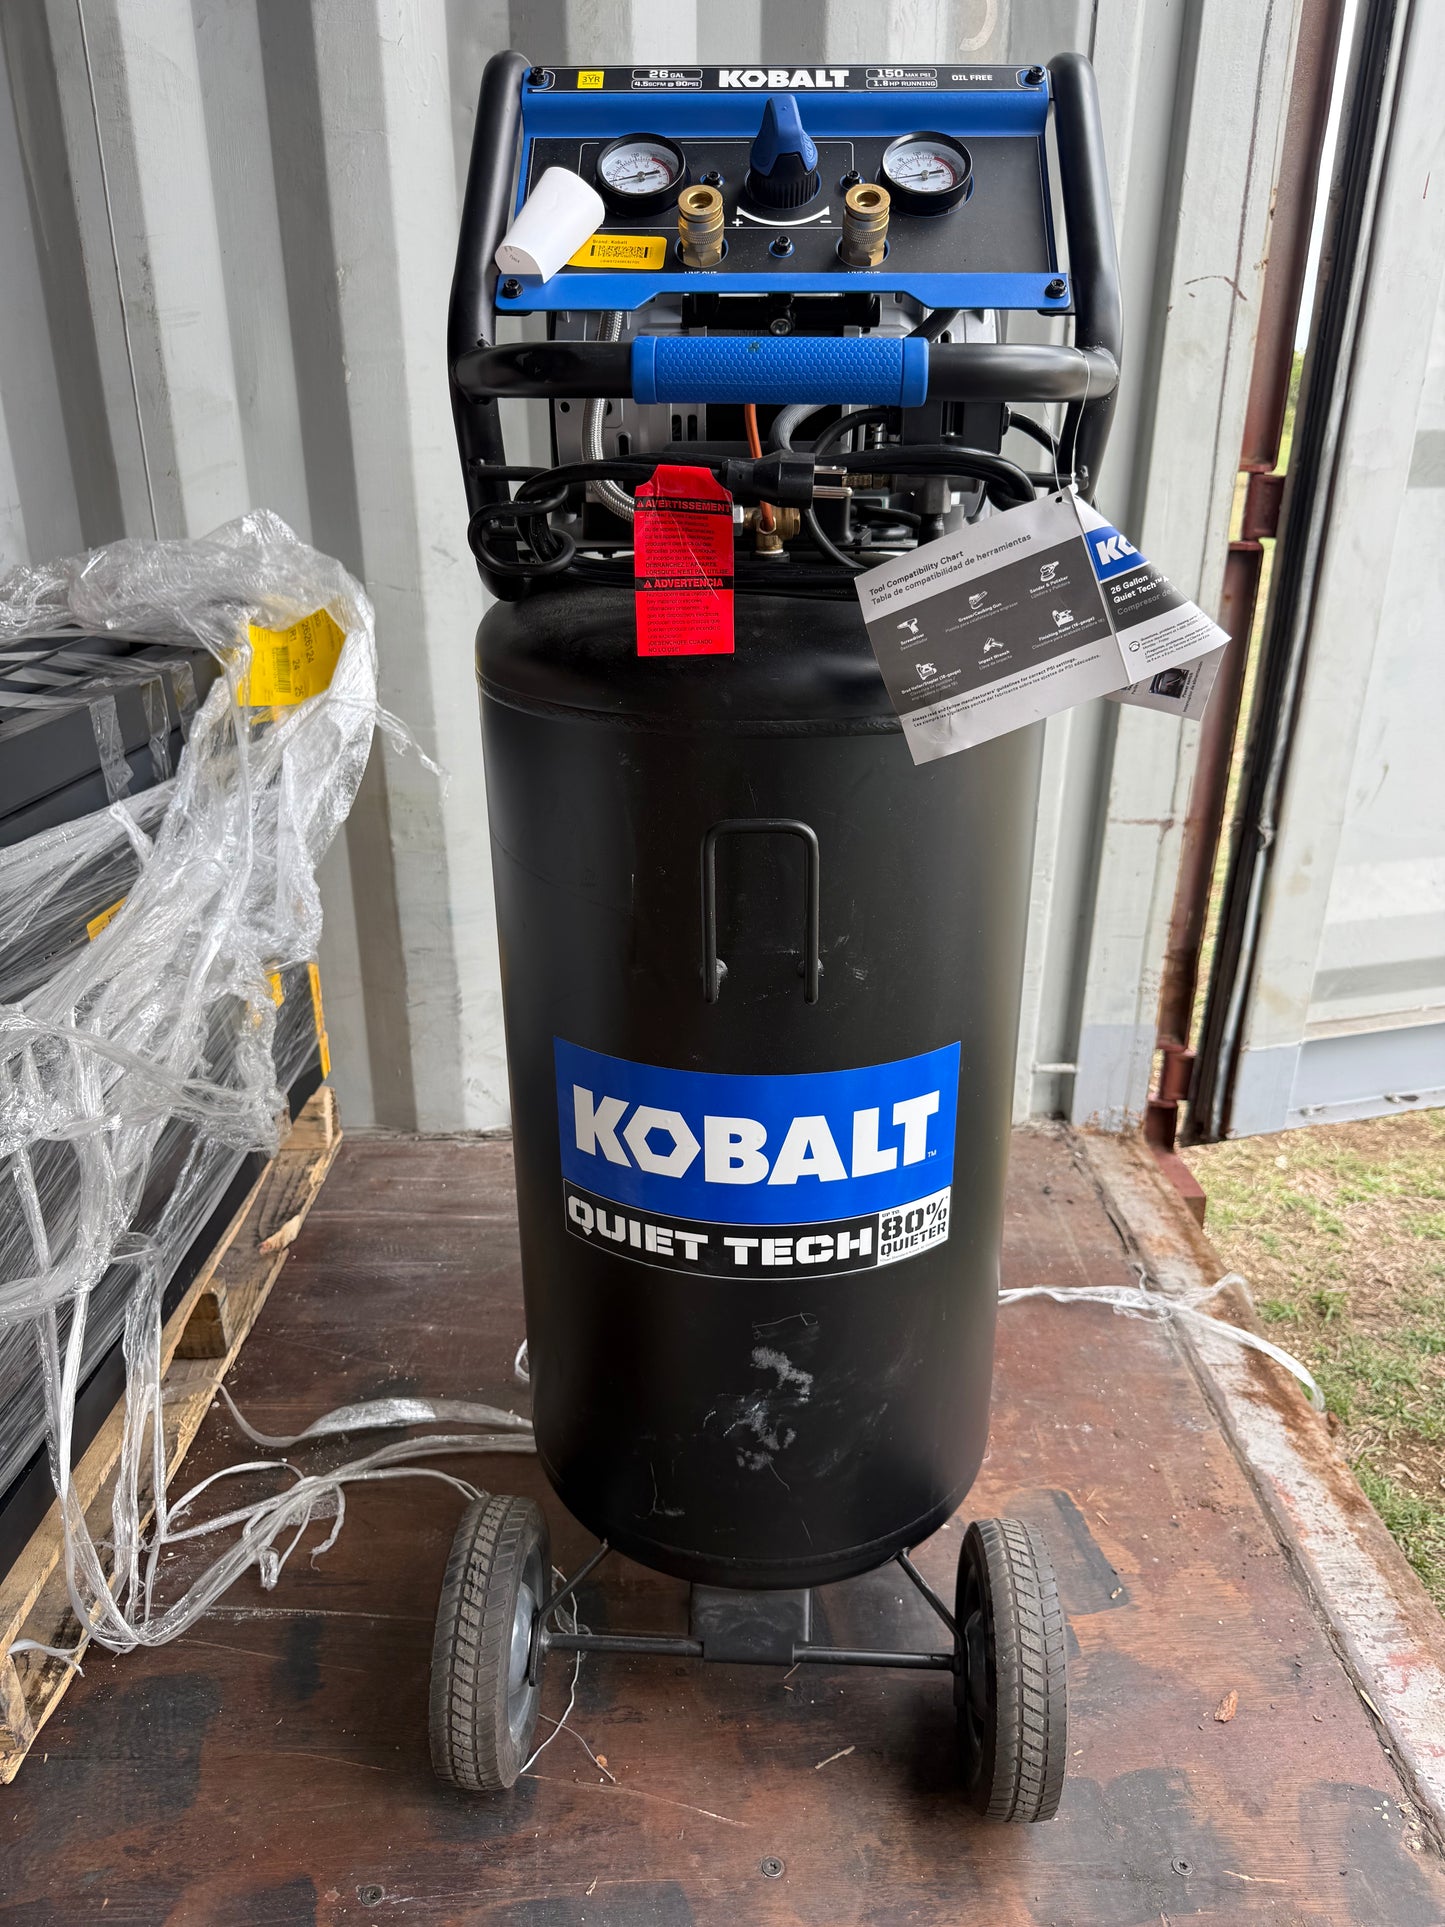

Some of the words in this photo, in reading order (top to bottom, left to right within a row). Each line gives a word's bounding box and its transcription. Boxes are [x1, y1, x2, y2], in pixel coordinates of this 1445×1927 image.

[649, 70, 668, 78] 26
[877, 69, 904, 77] 150
[645, 499, 731, 512] AVERTISSEMENT
[869, 584, 885, 595] Tool
[886, 561, 939, 588] Compatibility
[940, 550, 964, 565] Chart
[871, 592, 892, 604] Tabla
[893, 587, 903, 595] de
[904, 561, 963, 592] compatibilidad
[964, 556, 975, 565] de
[976, 533, 1031, 560] herramientas
[654, 577, 723, 588] ADVERTENCIA
[1109, 584, 1121, 594] 26
[1122, 572, 1148, 590] Gallon
[1112, 588, 1136, 604] Quiet
[1116, 590, 1161, 617] Compresor
[572, 1084, 940, 1186] KOBALT
[568, 1195, 708, 1260] QUIET
[724, 1226, 872, 1266] TECH
[881, 1221, 946, 1257] QUIETER
